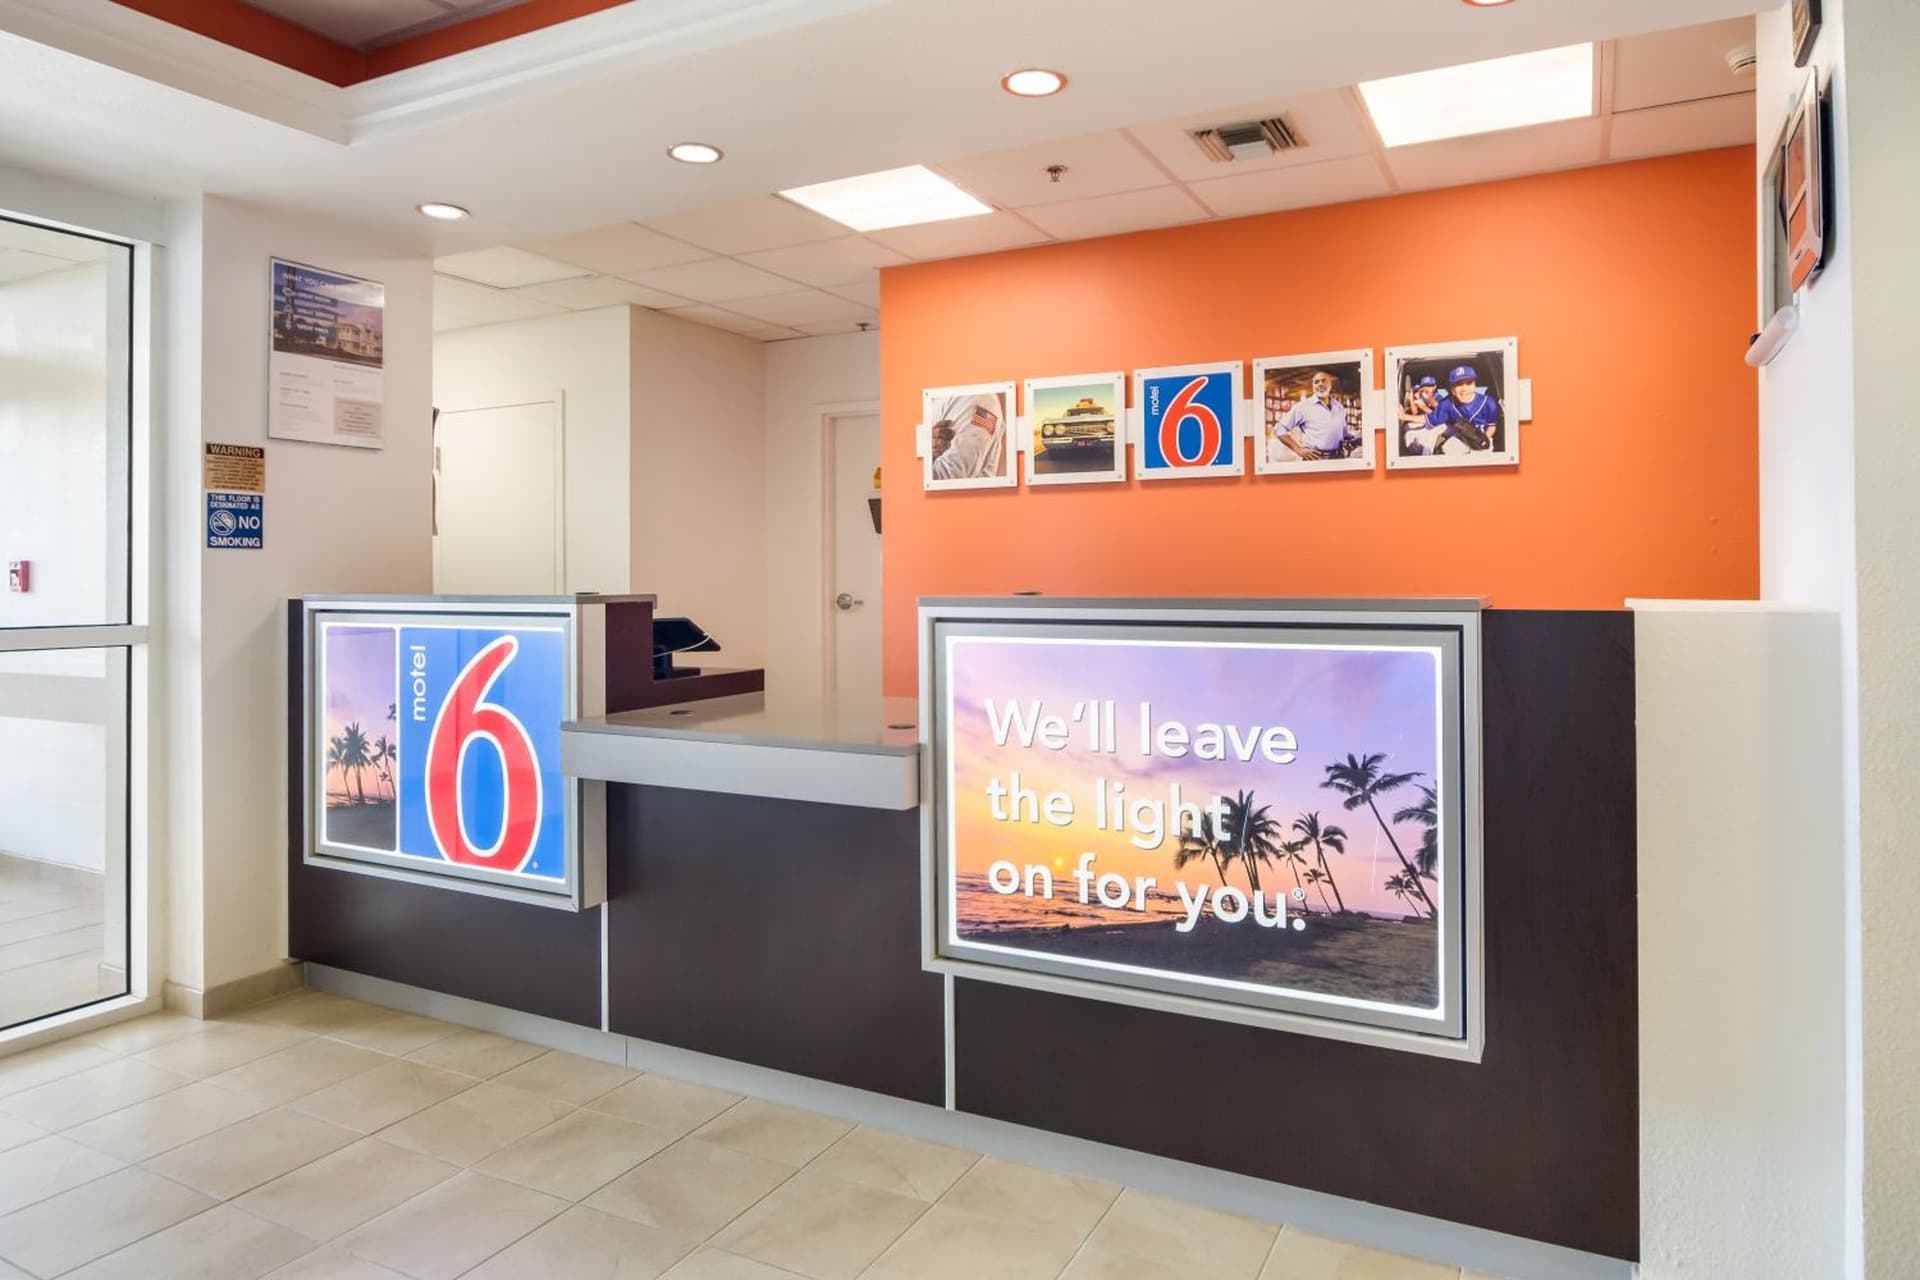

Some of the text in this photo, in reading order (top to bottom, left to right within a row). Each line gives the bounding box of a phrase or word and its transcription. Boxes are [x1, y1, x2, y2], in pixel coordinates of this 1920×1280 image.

[210, 445, 261, 457] WARNING
[1149, 376, 1222, 468] motel 6
[210, 501, 248, 509] DESIGNATED
[238, 515, 260, 530] NO
[210, 536, 261, 547] SMOKING
[410, 635, 543, 873] motel 6
[1140, 702, 1299, 765] leave
[986, 771, 1232, 850] the light
[988, 859, 1053, 900] on
[1073, 852, 1158, 911] for
